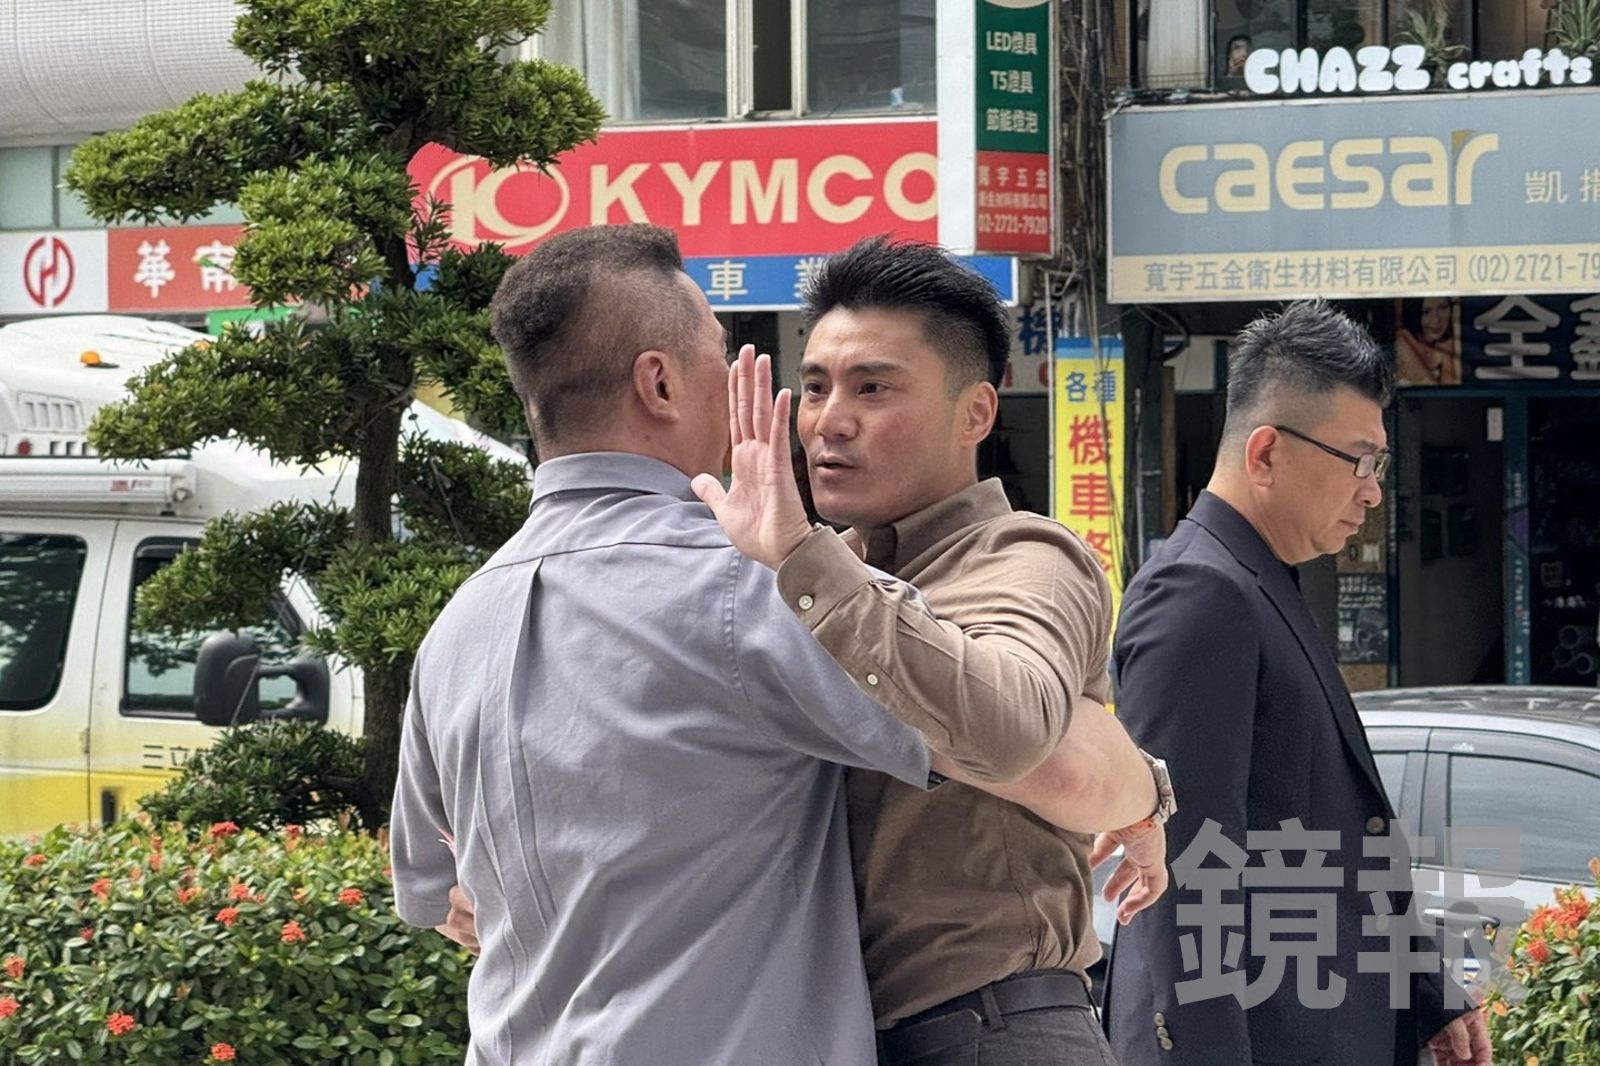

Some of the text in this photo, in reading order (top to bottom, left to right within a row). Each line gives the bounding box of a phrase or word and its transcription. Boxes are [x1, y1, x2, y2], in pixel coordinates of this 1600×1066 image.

[985, 30, 1038, 55] LED燈具
[1244, 44, 1594, 94] CHAZZ crafts
[590, 151, 938, 227] KYMCO
[133, 239, 239, 299] 華南
[1064, 370, 1117, 403] 各種
[142, 744, 214, 773] 三立
